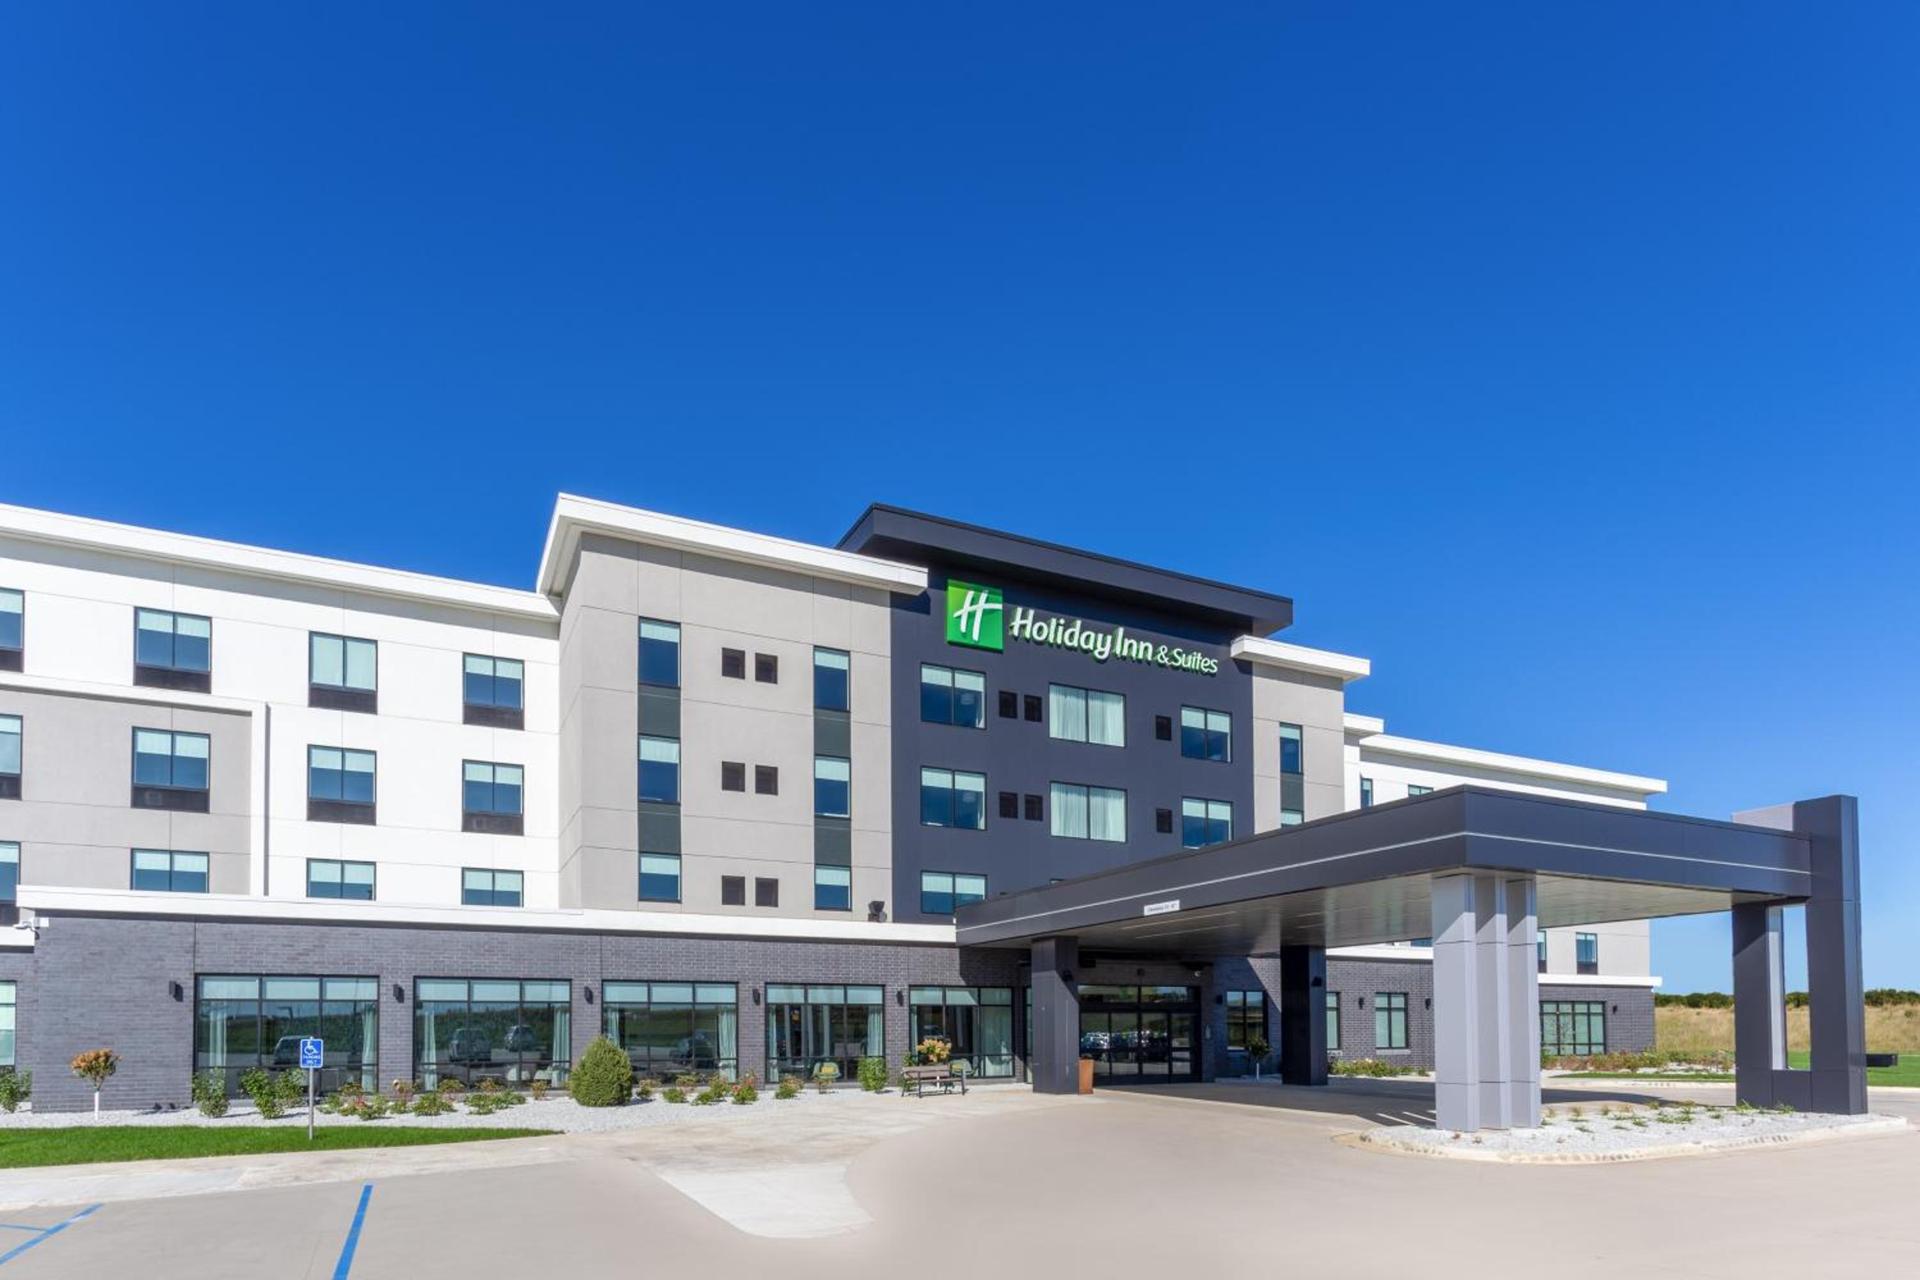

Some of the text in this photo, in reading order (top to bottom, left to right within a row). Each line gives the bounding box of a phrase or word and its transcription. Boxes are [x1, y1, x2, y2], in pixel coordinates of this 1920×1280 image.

[954, 590, 1002, 642] H
[1010, 607, 1218, 674] Holiday Inn & Suites
